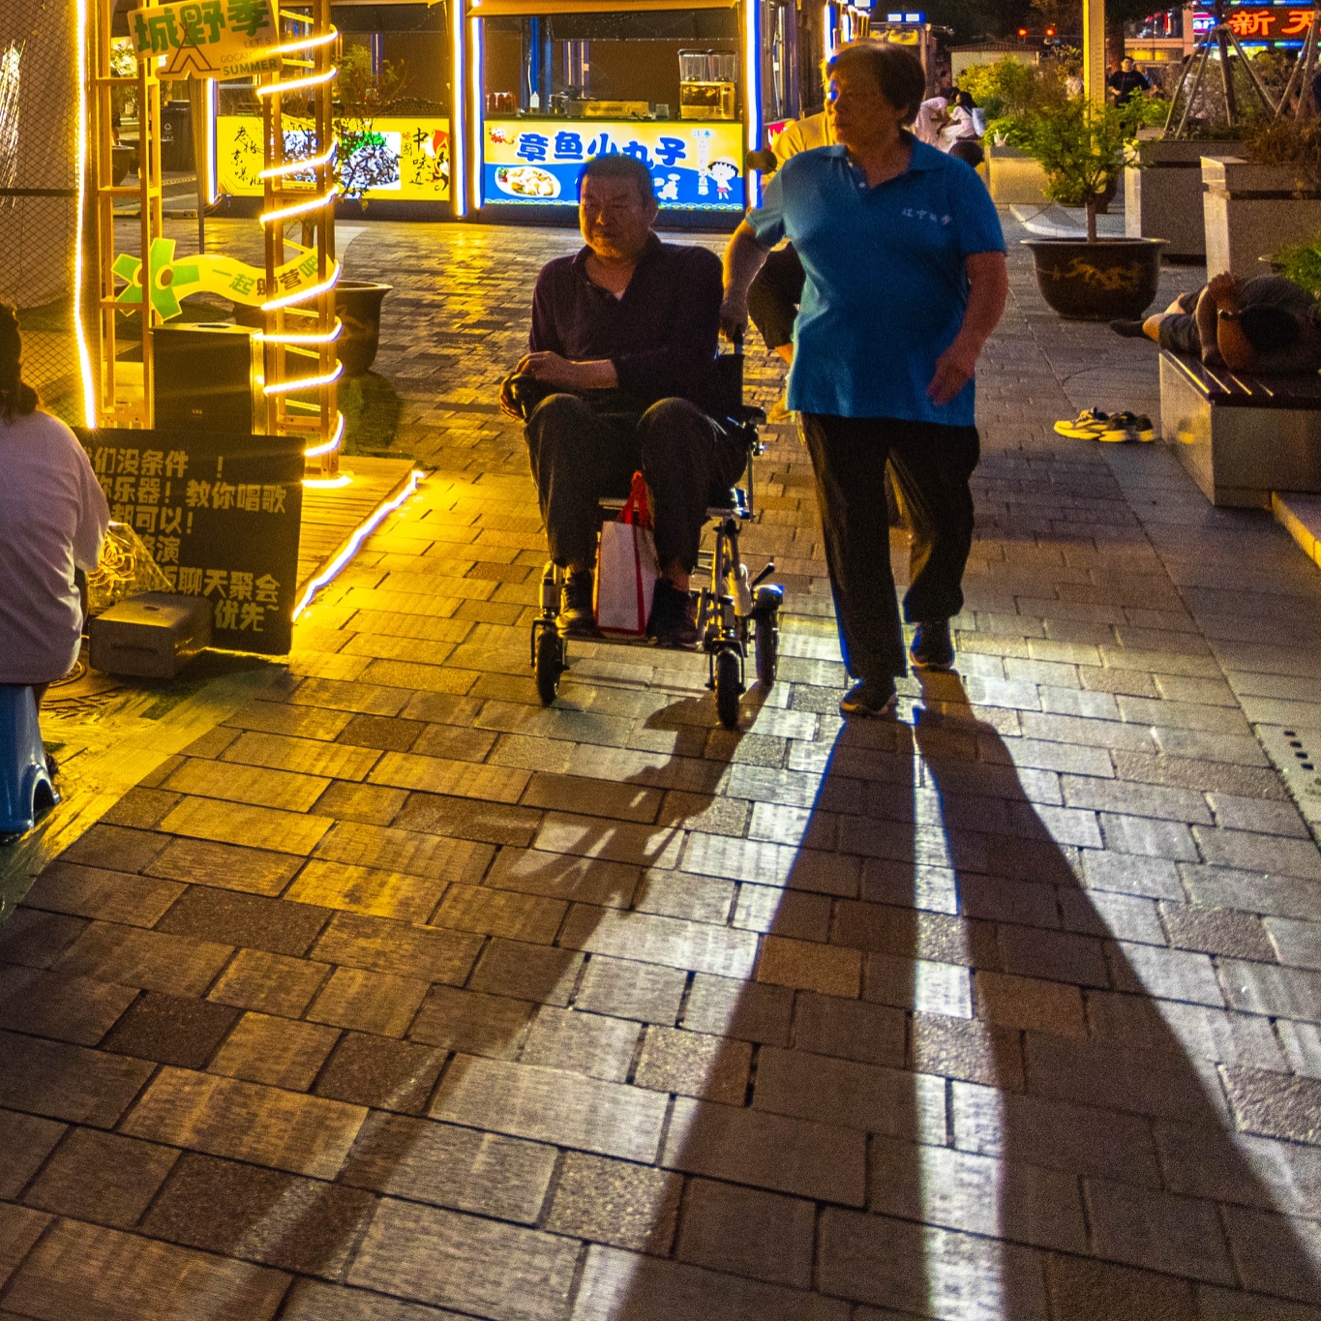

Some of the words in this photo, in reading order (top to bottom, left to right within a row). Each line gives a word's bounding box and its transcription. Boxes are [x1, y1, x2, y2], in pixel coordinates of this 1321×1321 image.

[223, 58, 278, 76] SUMMER
[517, 131, 687, 171] 章鱼小丸子
